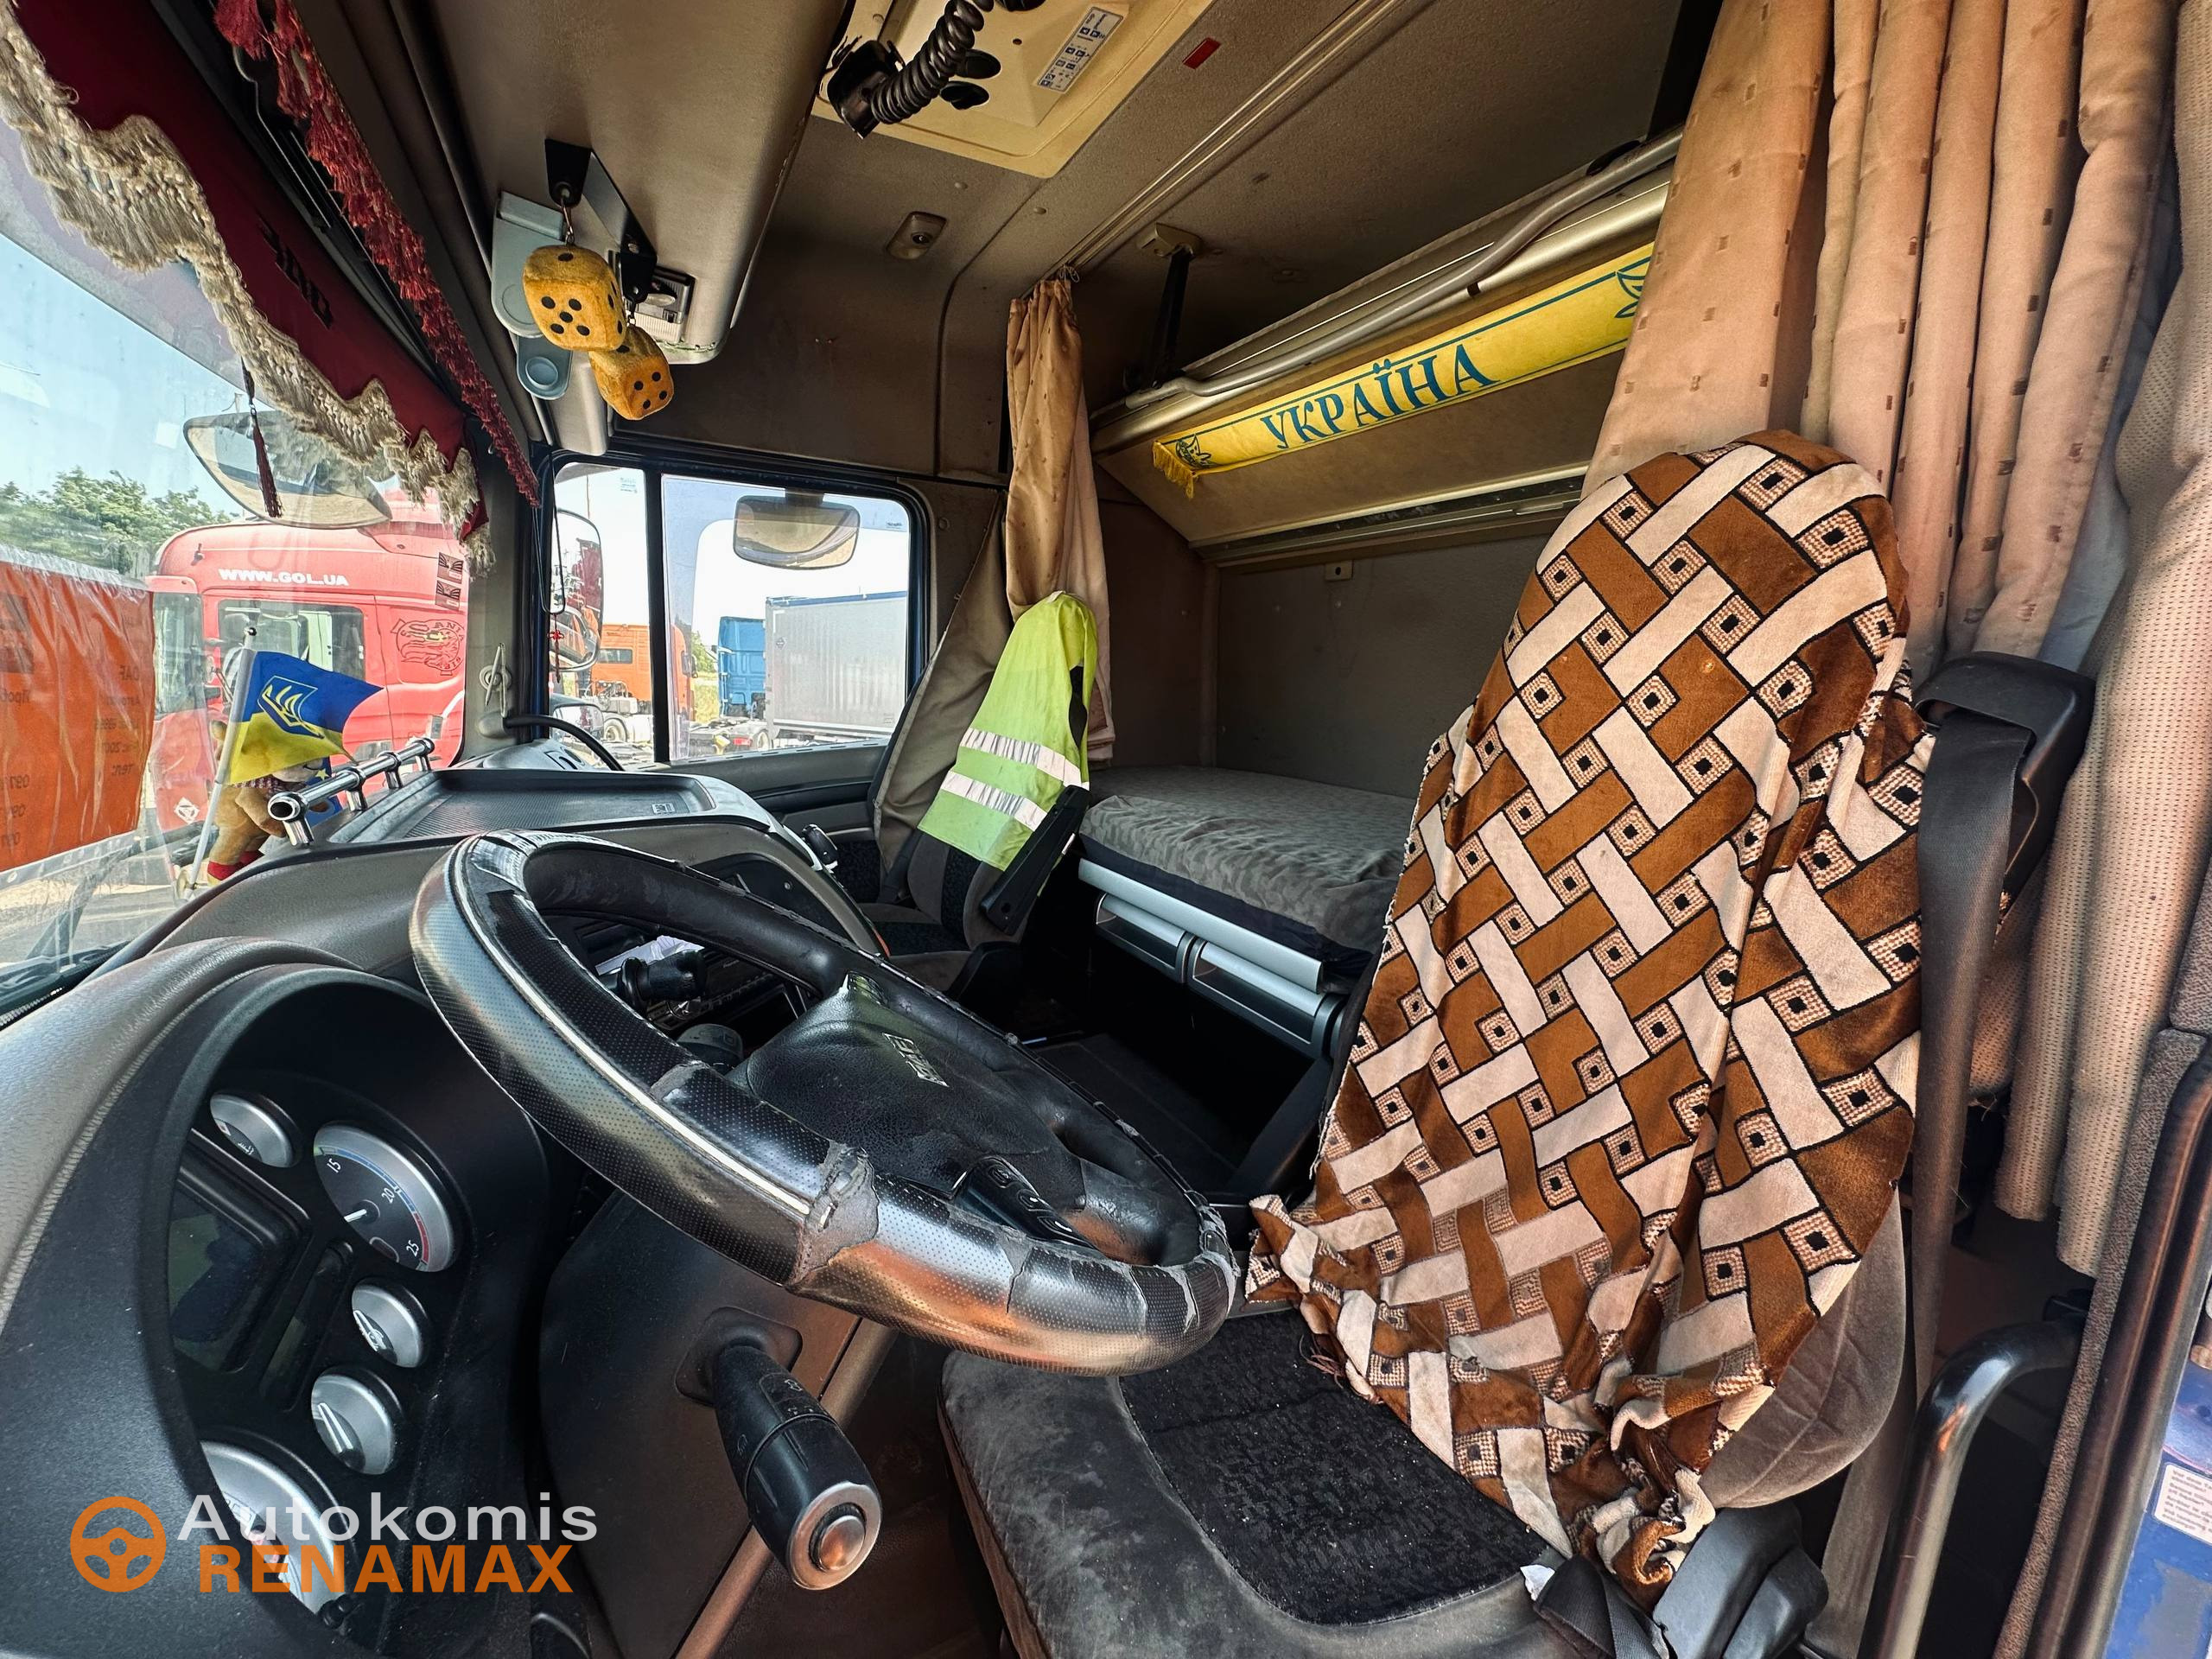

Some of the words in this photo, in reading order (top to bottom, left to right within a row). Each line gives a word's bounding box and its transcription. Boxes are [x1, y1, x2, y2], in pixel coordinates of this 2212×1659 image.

[1260, 344, 1499, 449] УКРАЇНА
[218, 568, 349, 587] WWW.GOL.UA
[327, 1158, 341, 1173] 15
[381, 1187, 395, 1204] 20
[406, 1240, 419, 1257] 25
